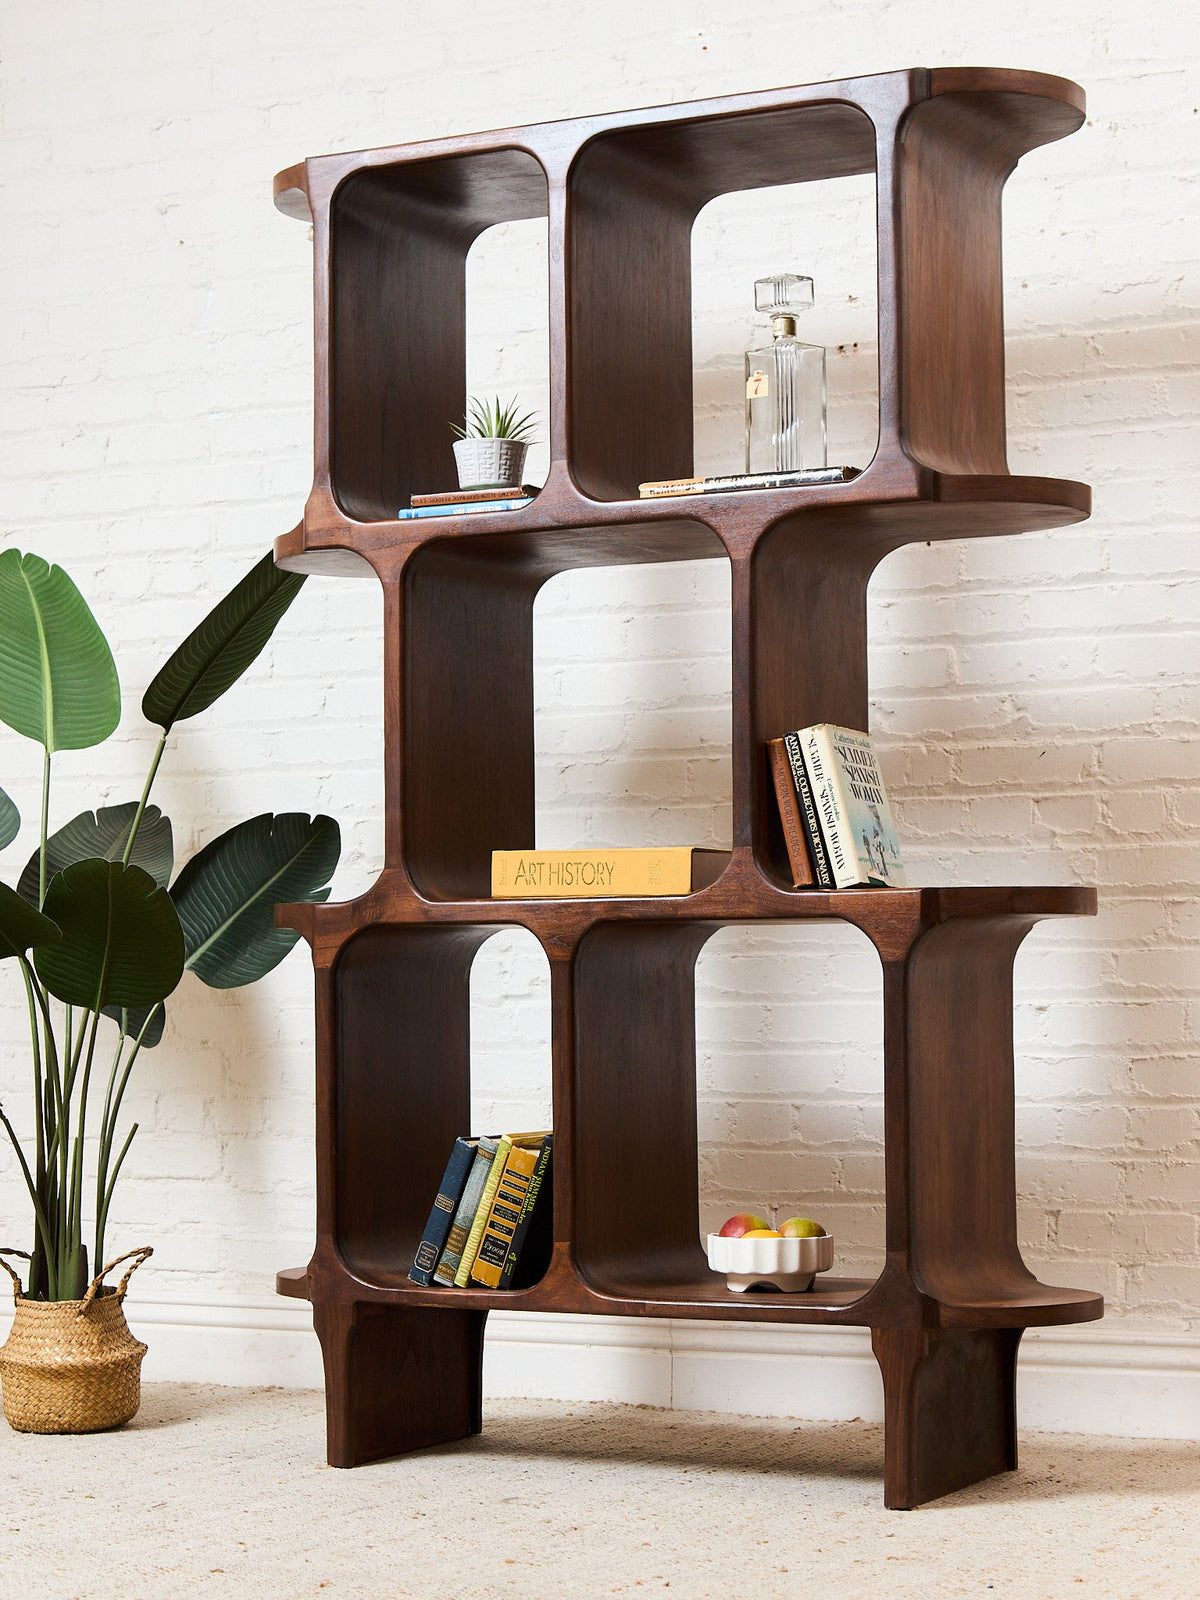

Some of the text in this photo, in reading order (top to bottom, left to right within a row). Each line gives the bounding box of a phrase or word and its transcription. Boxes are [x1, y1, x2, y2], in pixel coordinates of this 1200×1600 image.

[753, 378, 762, 395] 7
[777, 767, 791, 798] MODERN
[845, 764, 881, 786] SPANISH
[850, 783, 884, 805] WOMAN
[784, 800, 794, 824] WORLD
[789, 735, 805, 776] ANTIQUE
[799, 776, 818, 832] COLLECTORS
[811, 831, 831, 885] DICTIONARY
[787, 825, 801, 858] READERS
[820, 788, 836, 829] SPANISH
[830, 831, 846, 870] WOMAN
[514, 858, 545, 885] ART
[549, 861, 616, 886] HISTORY
[527, 1146, 551, 1212] INDIAN SUMMER
[519, 1174, 538, 1224] John Knowles
